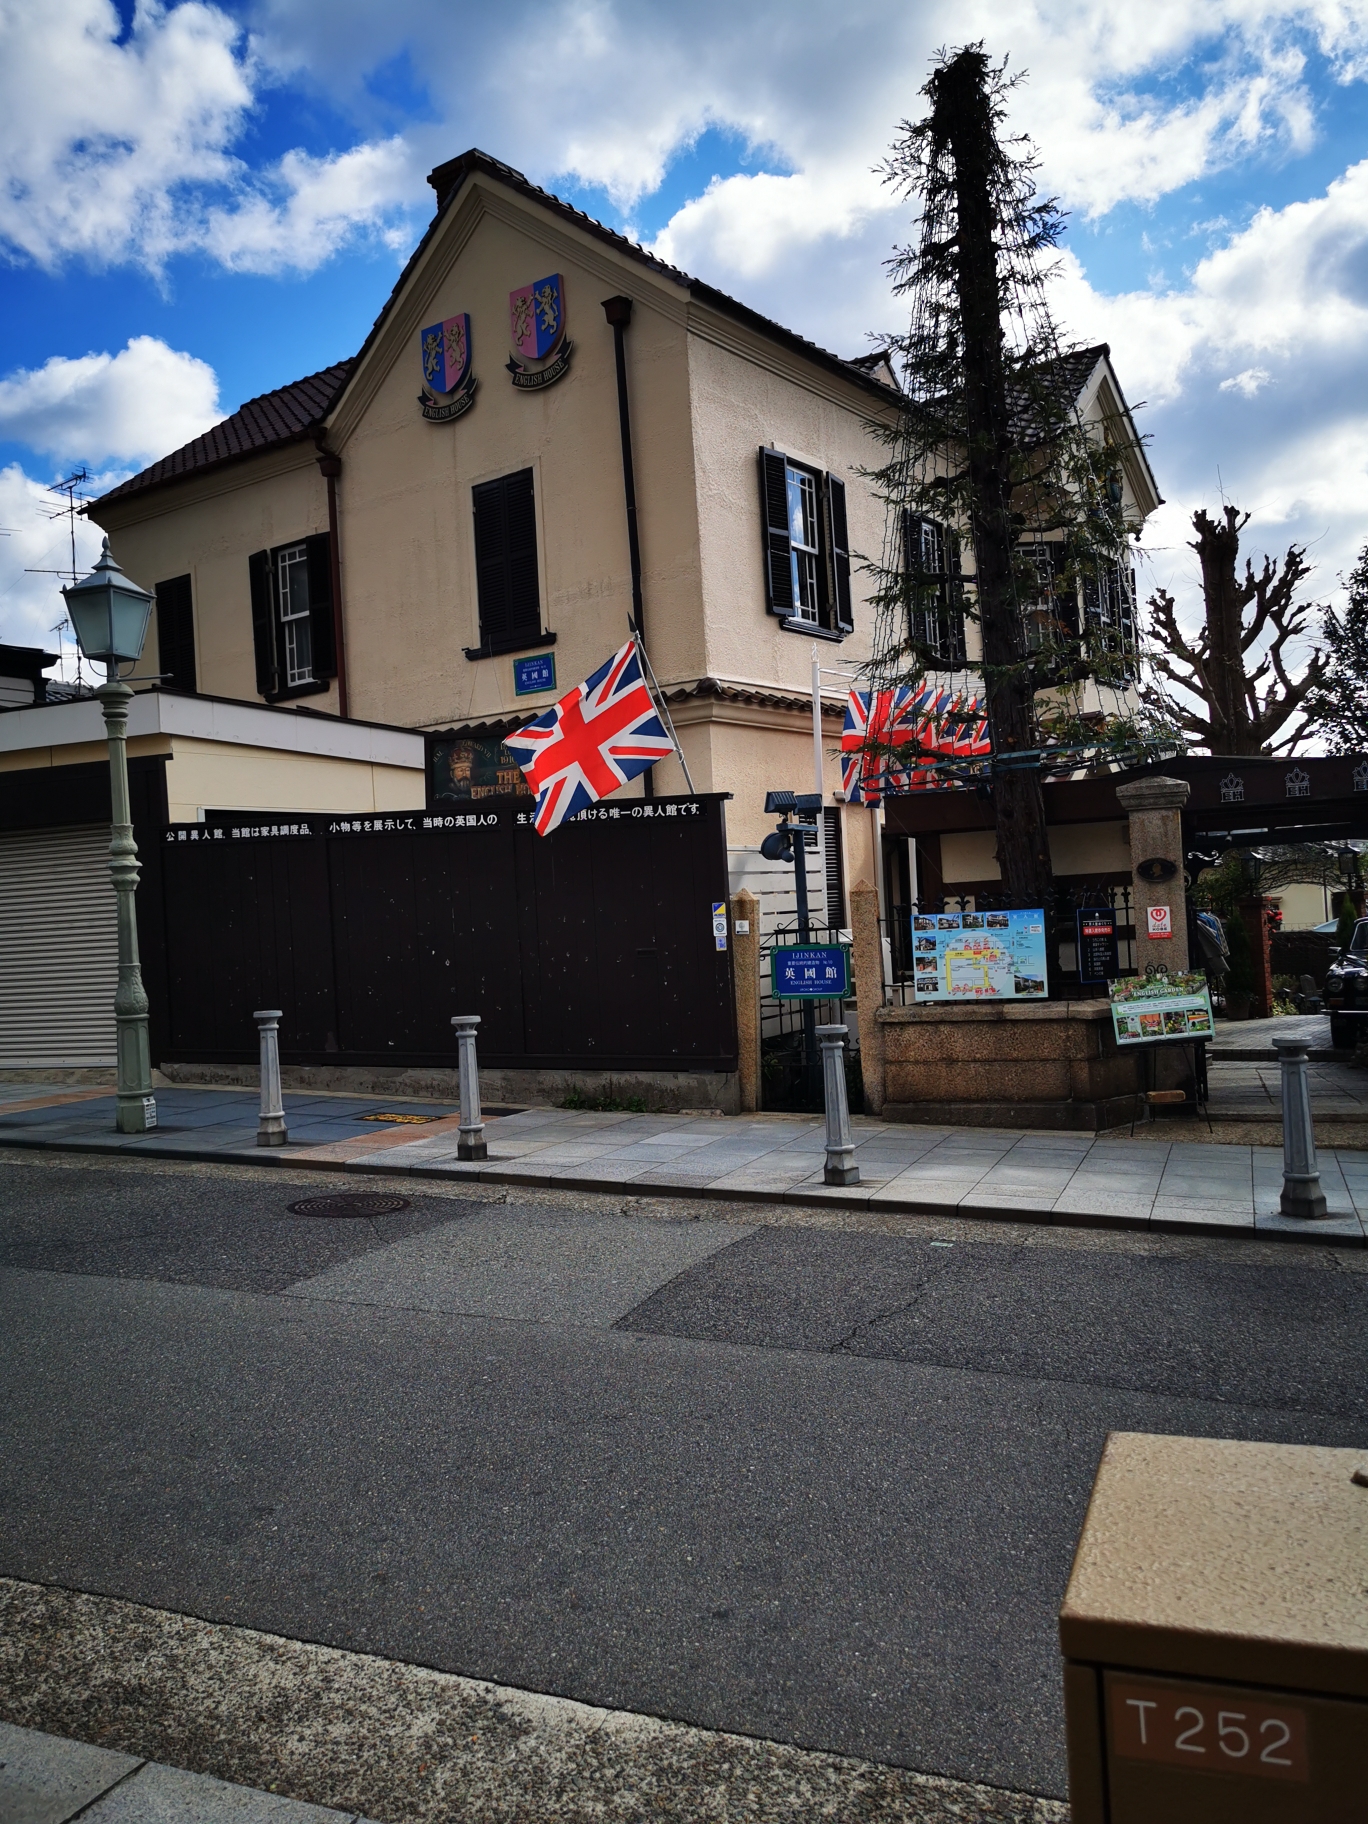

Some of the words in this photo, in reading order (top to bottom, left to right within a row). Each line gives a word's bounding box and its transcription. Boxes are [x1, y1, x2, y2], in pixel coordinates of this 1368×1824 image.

[514, 373, 543, 386] ENGLISH
[543, 359, 565, 383] HOUSE
[424, 405, 450, 418] ENGLISH
[450, 393, 471, 414] HOUSE
[496, 768, 521, 785] THE
[470, 784, 513, 800] ENGLISH
[792, 951, 827, 959] IJINKAN
[785, 966, 838, 980] 英國館
[1125, 1698, 1292, 1767] T252
